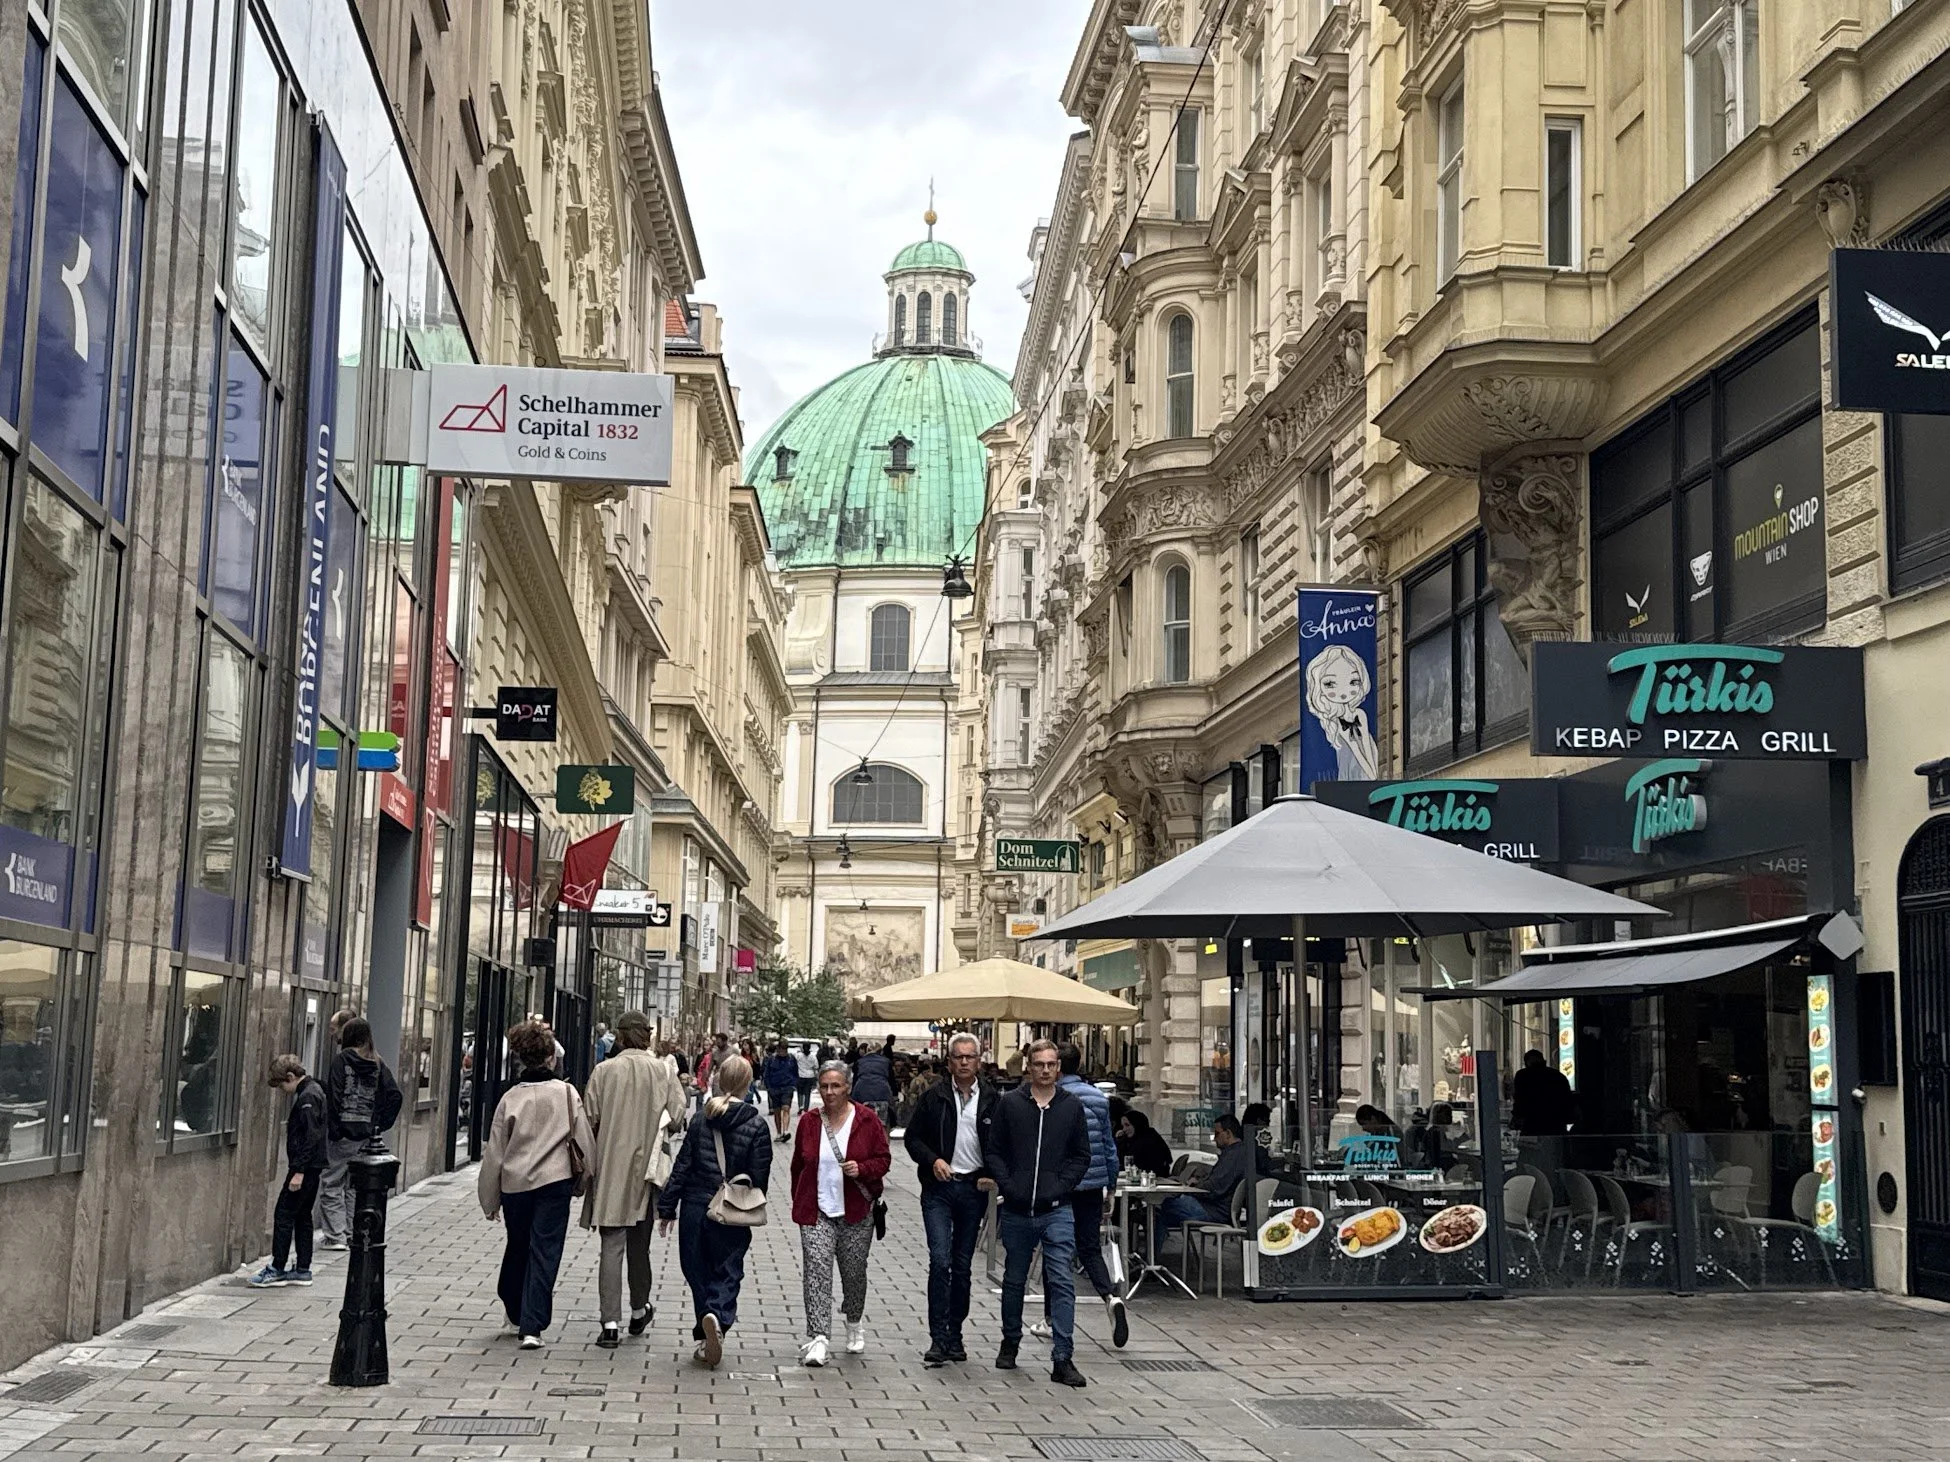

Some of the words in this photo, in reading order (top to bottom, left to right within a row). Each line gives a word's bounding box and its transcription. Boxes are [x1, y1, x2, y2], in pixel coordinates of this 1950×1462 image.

[1894, 353, 1950, 370] SALE
[519, 394, 662, 418] Schelhammer
[518, 417, 590, 440] Capital
[597, 423, 639, 440] 1832
[518, 445, 551, 459] Gold
[554, 447, 565, 459] &
[568, 447, 607, 462] Coins
[1735, 511, 1788, 561] MOUNTAIN
[1789, 496, 1819, 535] SHOP
[1765, 542, 1787, 566] WIEN
[1300, 599, 1376, 641] Anna
[1607, 643, 1785, 726] Türkis
[1556, 727, 1643, 749] KEBAP
[1664, 729, 1740, 751] PIZZA
[1761, 730, 1838, 753] GRILL
[1369, 780, 1500, 833] Türkis
[1625, 757, 1706, 855] Türkis
[1001, 841, 1034, 854] Dom
[1484, 843, 1541, 860] GRILL
[999, 854, 1059, 868] Schnitzel
[632, 897, 641, 909] 5
[1423, 1198, 1448, 1206] Döner
